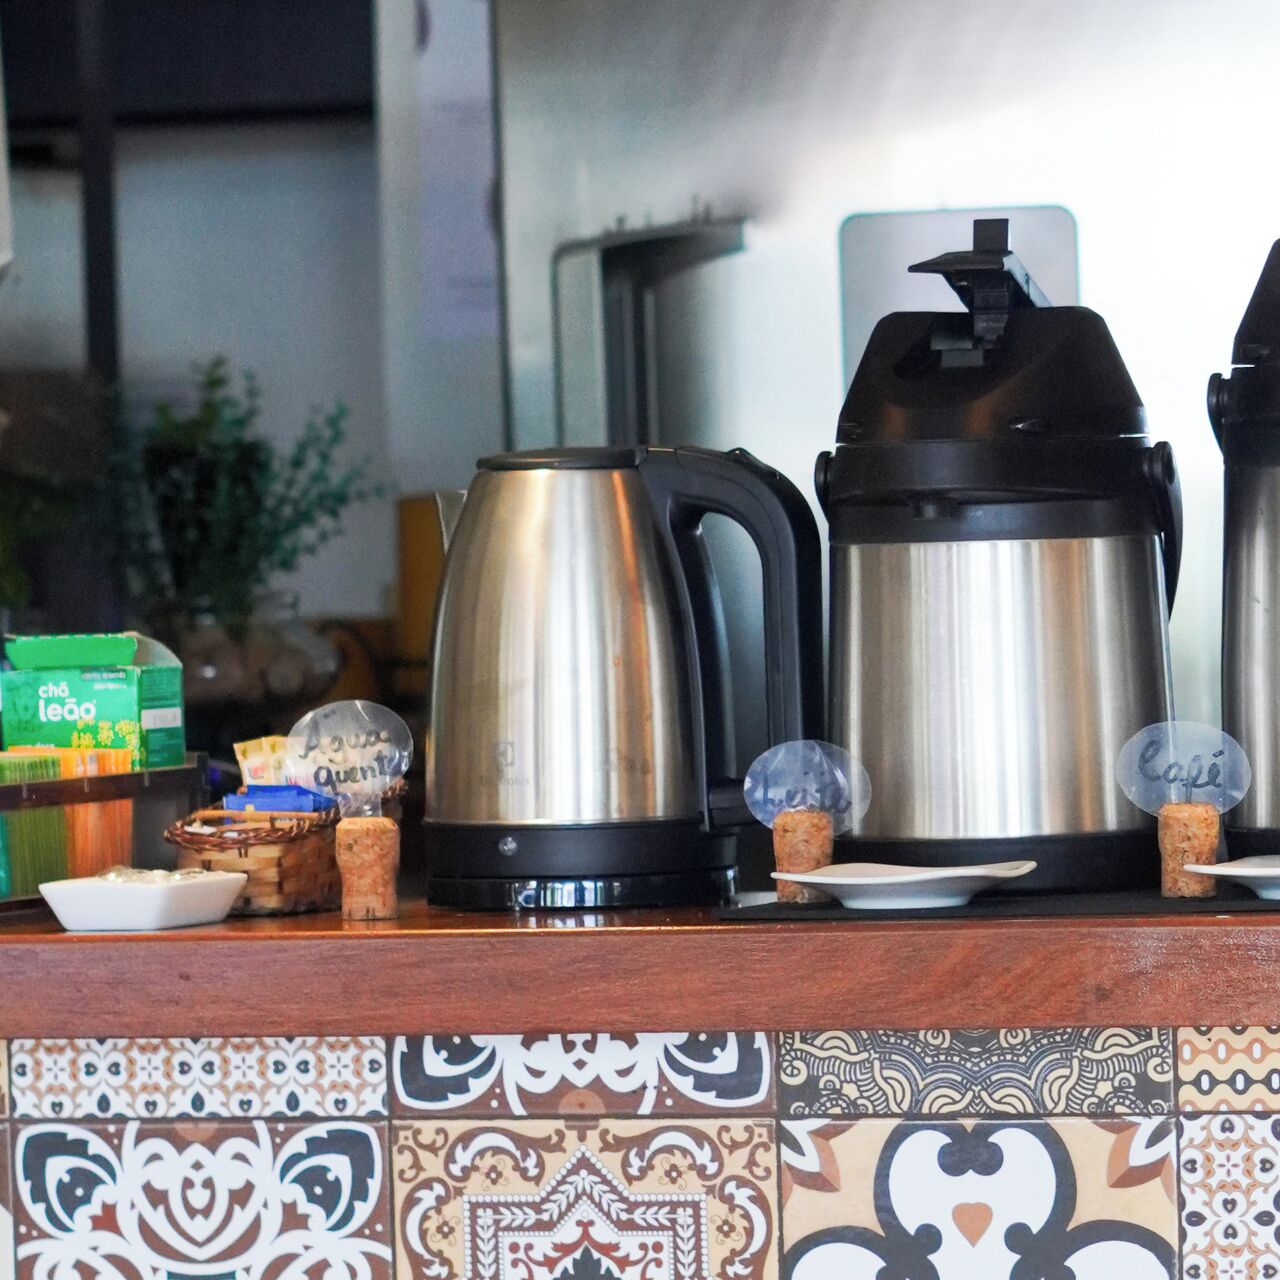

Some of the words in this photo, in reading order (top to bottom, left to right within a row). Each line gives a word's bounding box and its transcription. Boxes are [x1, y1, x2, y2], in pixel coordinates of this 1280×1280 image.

[38, 682, 70, 698] chá
[38, 698, 96, 722] leão
[1138, 739, 1225, 804] Café
